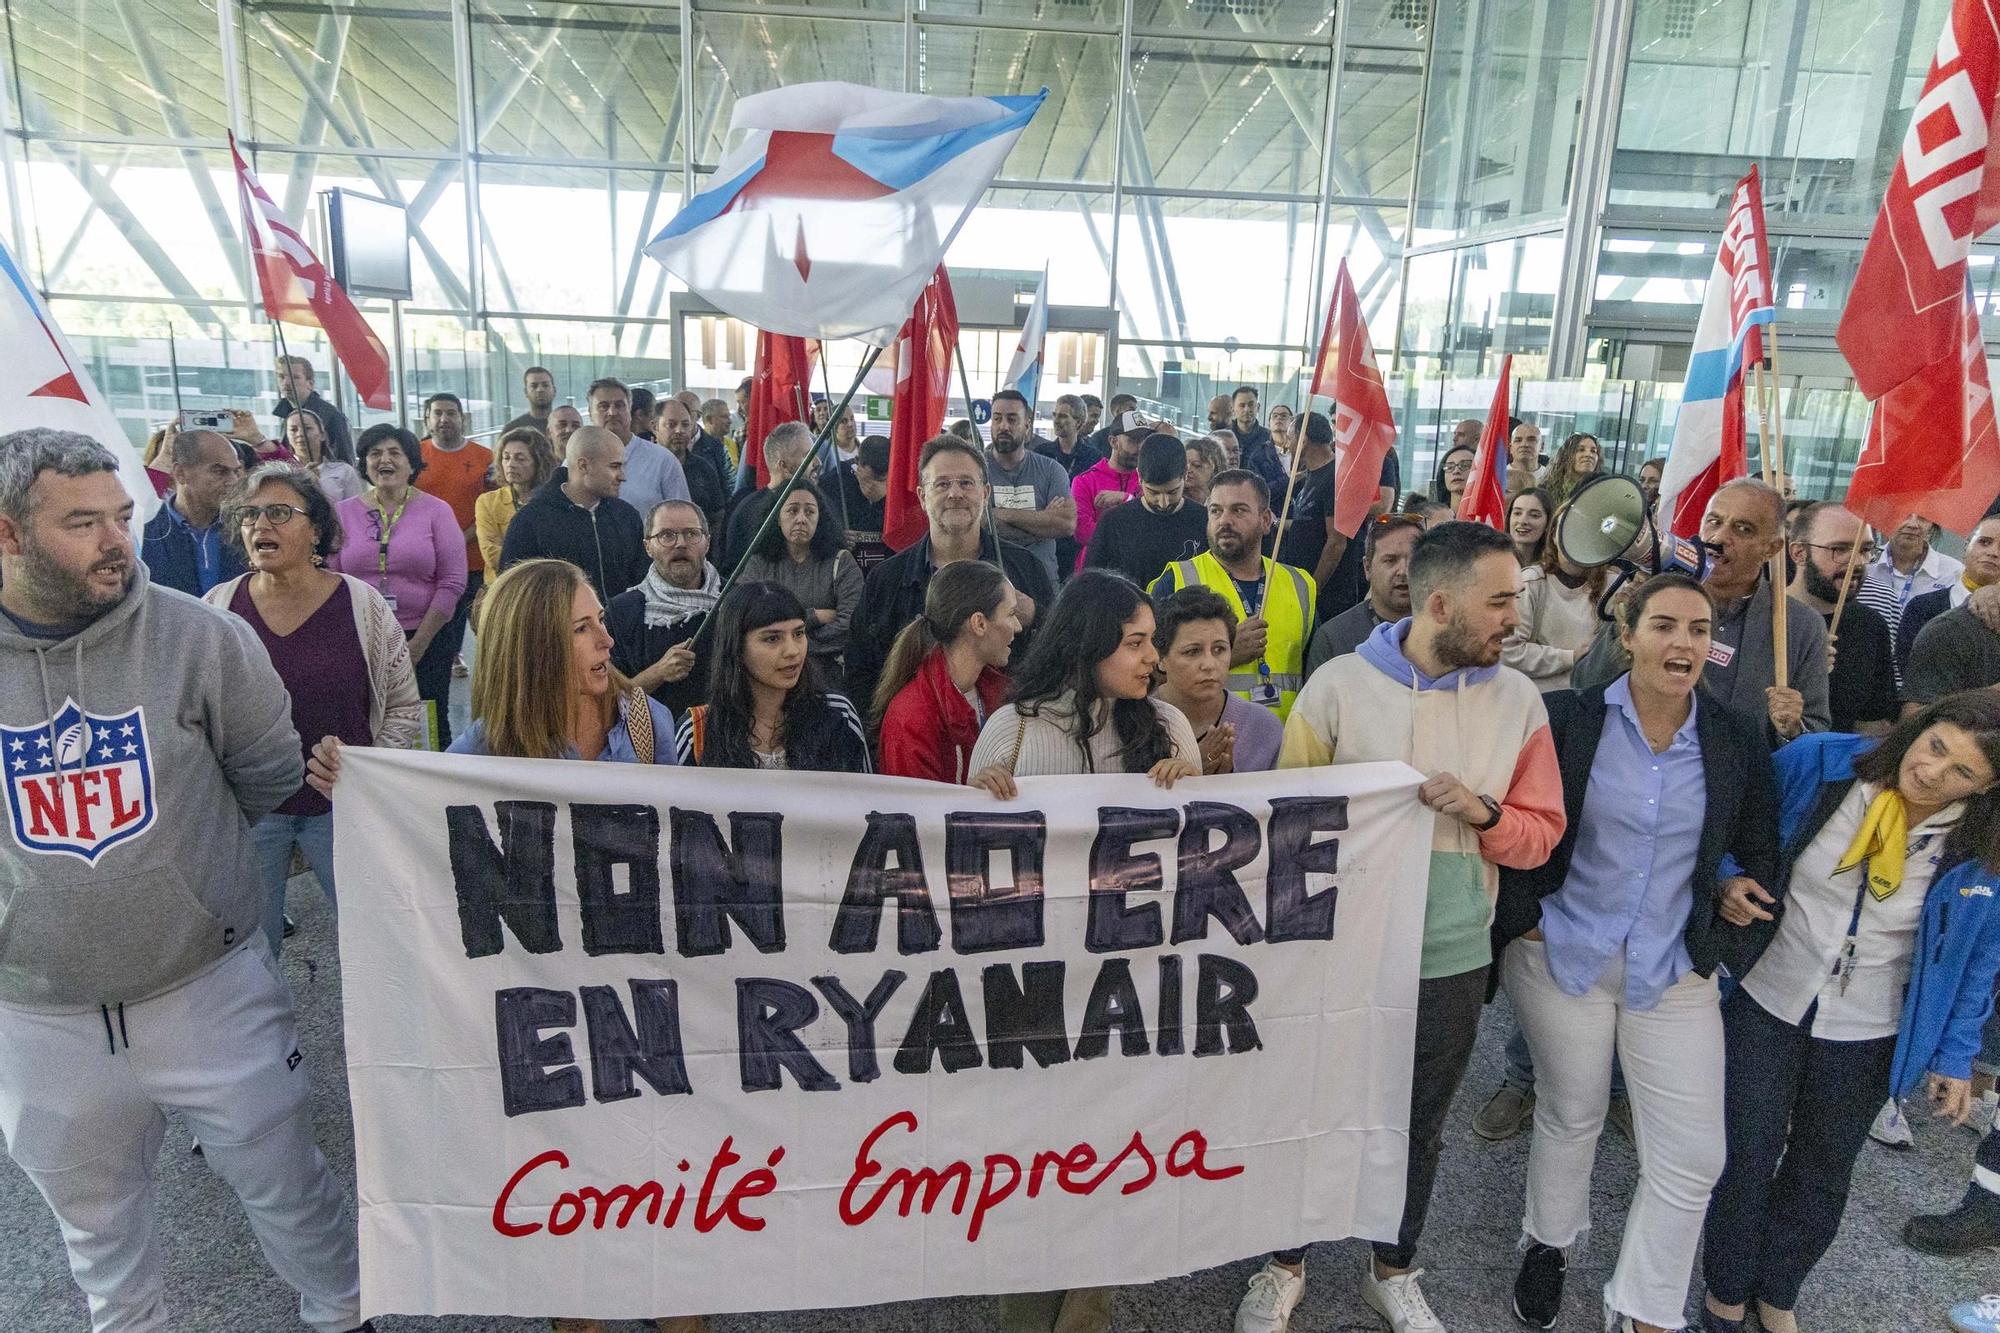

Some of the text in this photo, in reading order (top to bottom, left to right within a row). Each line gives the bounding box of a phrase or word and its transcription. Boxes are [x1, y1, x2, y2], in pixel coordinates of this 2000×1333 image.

[21, 768, 141, 840] NFL
[446, 796, 1349, 959] NON AO ERE
[496, 954, 1264, 1117] EN RYANAIR
[493, 1111, 1244, 1242] Comité Empresa
